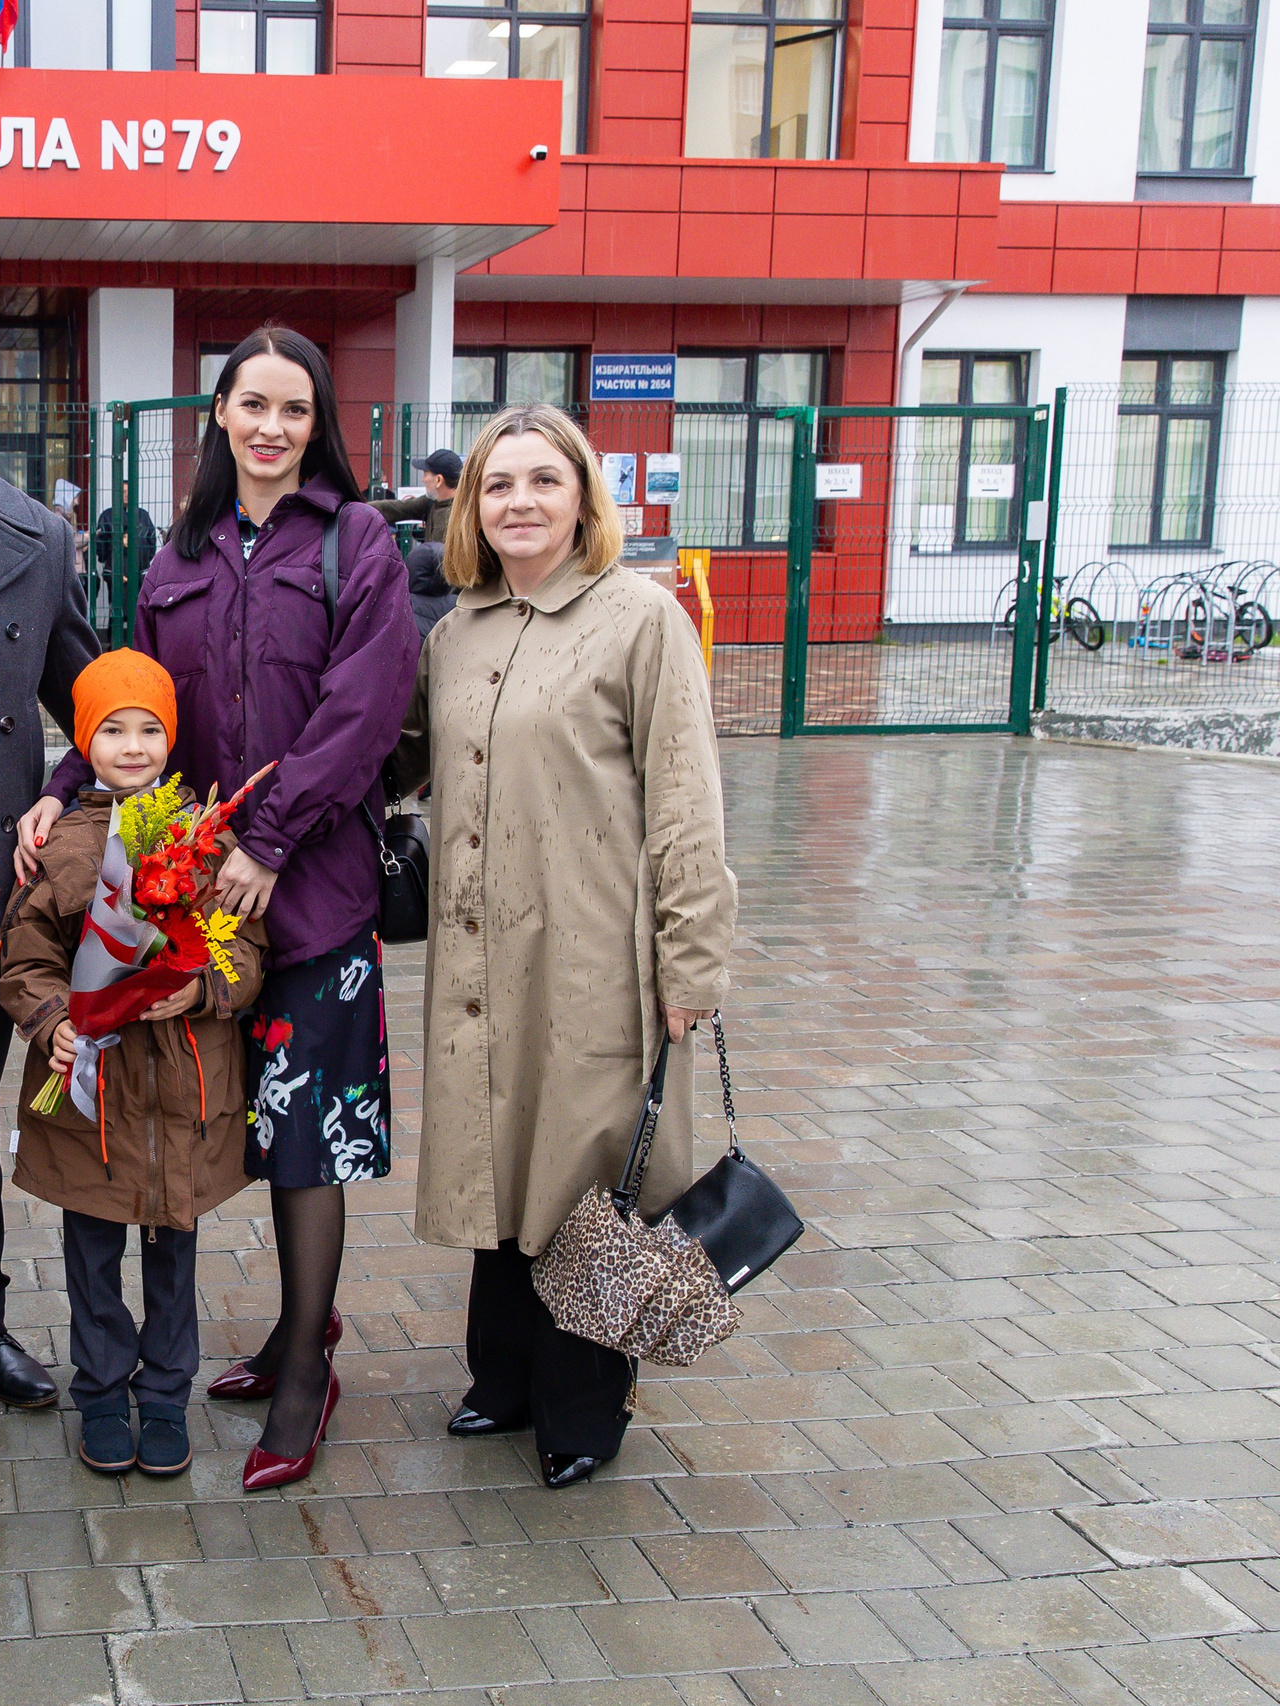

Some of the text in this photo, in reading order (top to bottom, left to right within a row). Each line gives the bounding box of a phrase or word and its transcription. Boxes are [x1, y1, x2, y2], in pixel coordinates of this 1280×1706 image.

[101, 119, 241, 171] №79
[596, 363, 672, 375] ИЗБИРАТЕЛЬНЫЙ
[596, 379, 636, 390] УЧАСТОК
[638, 379, 649, 390] №
[828, 467, 850, 475] ВХОД
[981, 467, 1002, 475] ВХОД
[219, 920, 233, 930] 1
[189, 911, 240, 983] ентября
